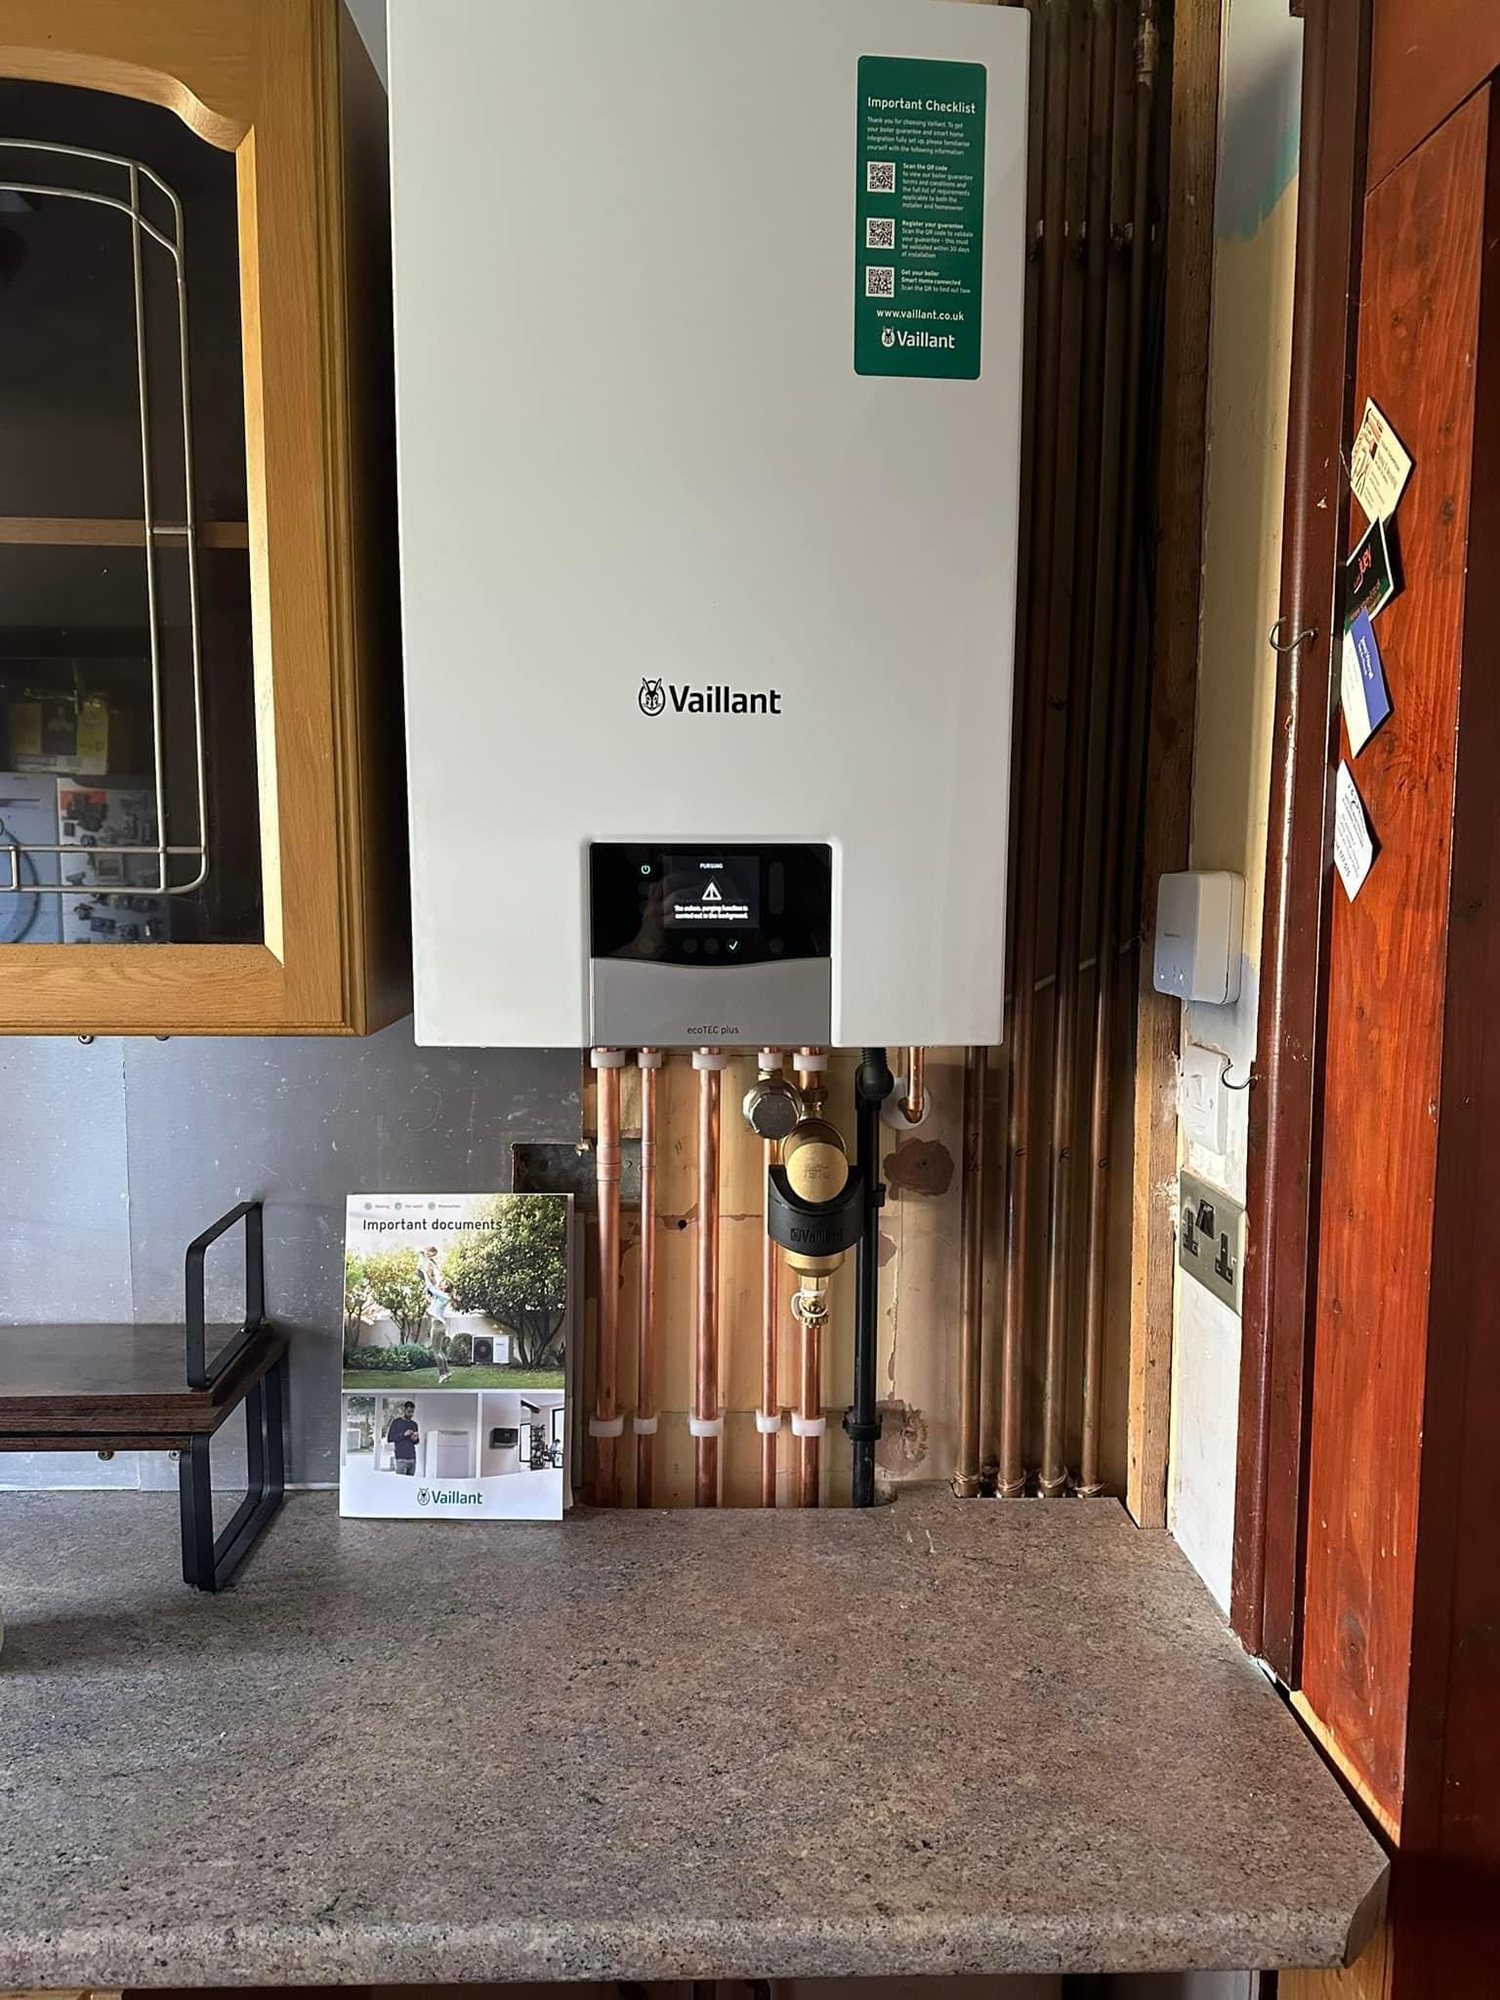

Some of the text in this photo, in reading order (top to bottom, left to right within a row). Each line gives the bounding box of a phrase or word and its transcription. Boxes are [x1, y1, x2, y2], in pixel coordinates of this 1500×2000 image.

[868, 97, 976, 114] Important Checklist
[868, 116, 883, 124] Thank
[954, 122, 963, 130] get
[949, 130, 964, 138] home
[911, 146, 934, 155] following
[902, 220, 924, 228] Register
[877, 309, 964, 321] www.vaillant.co.uk
[897, 330, 955, 348] Vaillant
[668, 685, 782, 714] Vaillant
[687, 1026, 739, 1036] ecoTEC plus
[363, 1218, 502, 1232] Important documents
[431, 1491, 483, 1504] Vaillant
